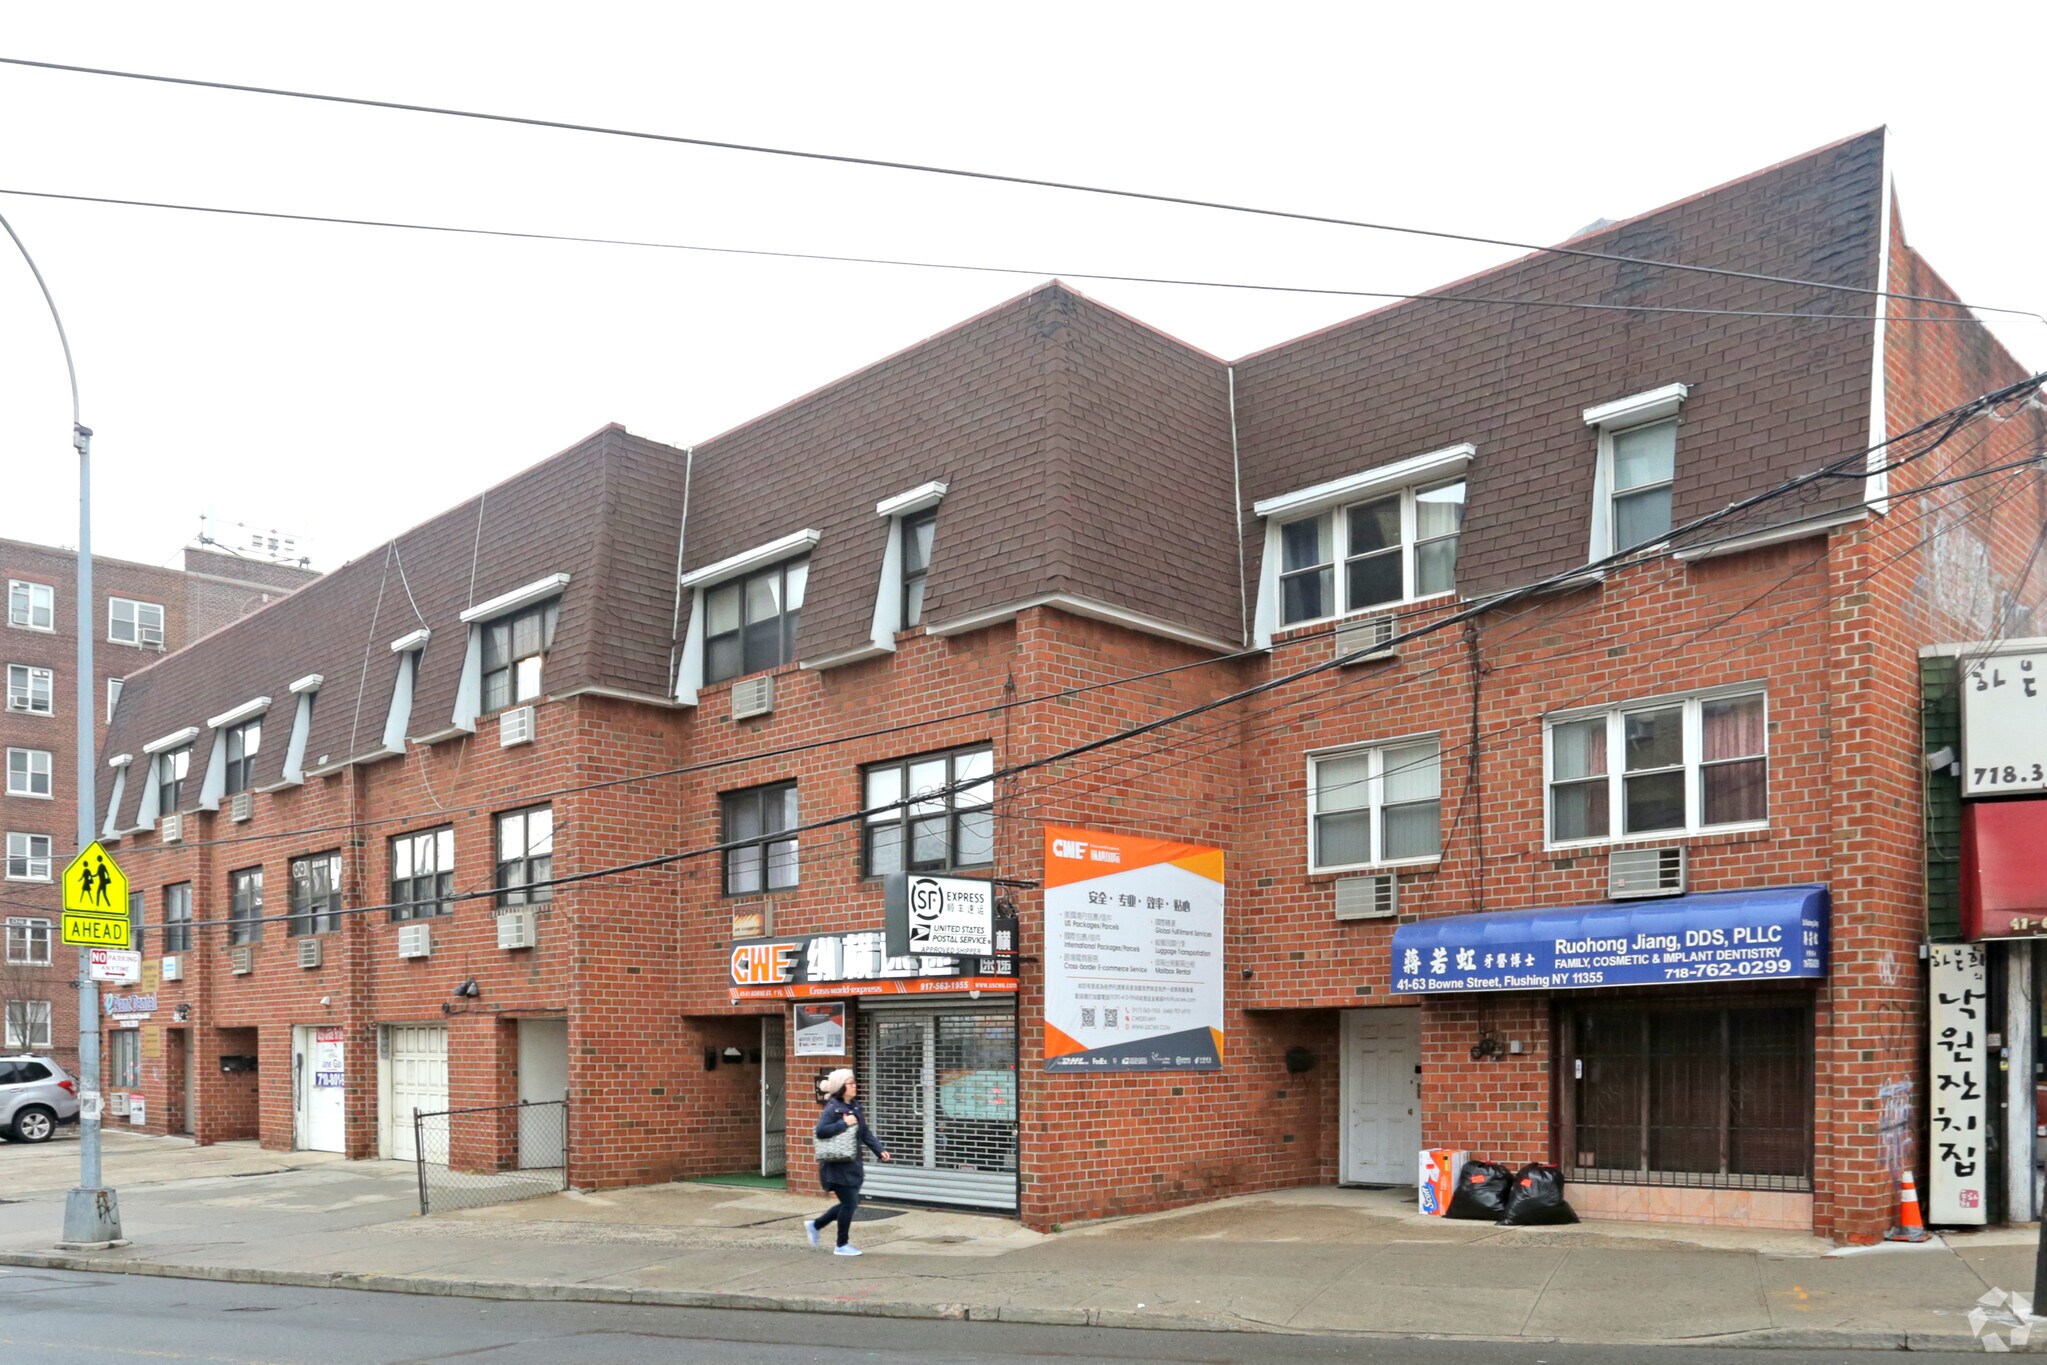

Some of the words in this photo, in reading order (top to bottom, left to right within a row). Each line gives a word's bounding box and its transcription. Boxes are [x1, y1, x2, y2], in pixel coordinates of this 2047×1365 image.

[917, 890, 937, 910] SF
[946, 891, 985, 904] EXPRESS
[1088, 891, 1107, 905] 安全
[71, 921, 122, 939] AHEAD
[934, 925, 960, 933] UNITED
[932, 935, 958, 943] POSTAL
[960, 936, 987, 944] SERVICE
[1064, 941, 1096, 949] International
[1555, 937, 1627, 954] Ruohong
[1632, 934, 1681, 951] Jiang,
[1685, 929, 1728, 947] DDS,
[1733, 925, 1782, 944] PLLC
[921, 946, 954, 954] APPROVED
[1155, 947, 1177, 955] Luggage
[1178, 948, 1211, 957] Transportation
[92, 952, 106, 963] NO
[108, 955, 137, 963] PARKING
[731, 942, 801, 984] CWE
[1484, 953, 1535, 968] 牙醫博士
[1555, 957, 1591, 969] FAMILY,
[1593, 954, 1649, 967] COSMETIC
[1651, 953, 1660, 964] &
[1663, 950, 1714, 963] IMPLANT
[1716, 947, 1782, 961] DENTISTRY
[1664, 959, 1792, 979] 718-762-0299
[920, 981, 969, 991] 917-563-1955
[1397, 978, 1426, 991] 41-63
[1428, 977, 1464, 989] Bowne
[1466, 975, 1501, 988] Street,
[1504, 974, 1550, 988] Flushing
[1552, 973, 1569, 984] NY
[1572, 972, 1603, 983] 11355
[1060, 1057, 1087, 1065] DHL
